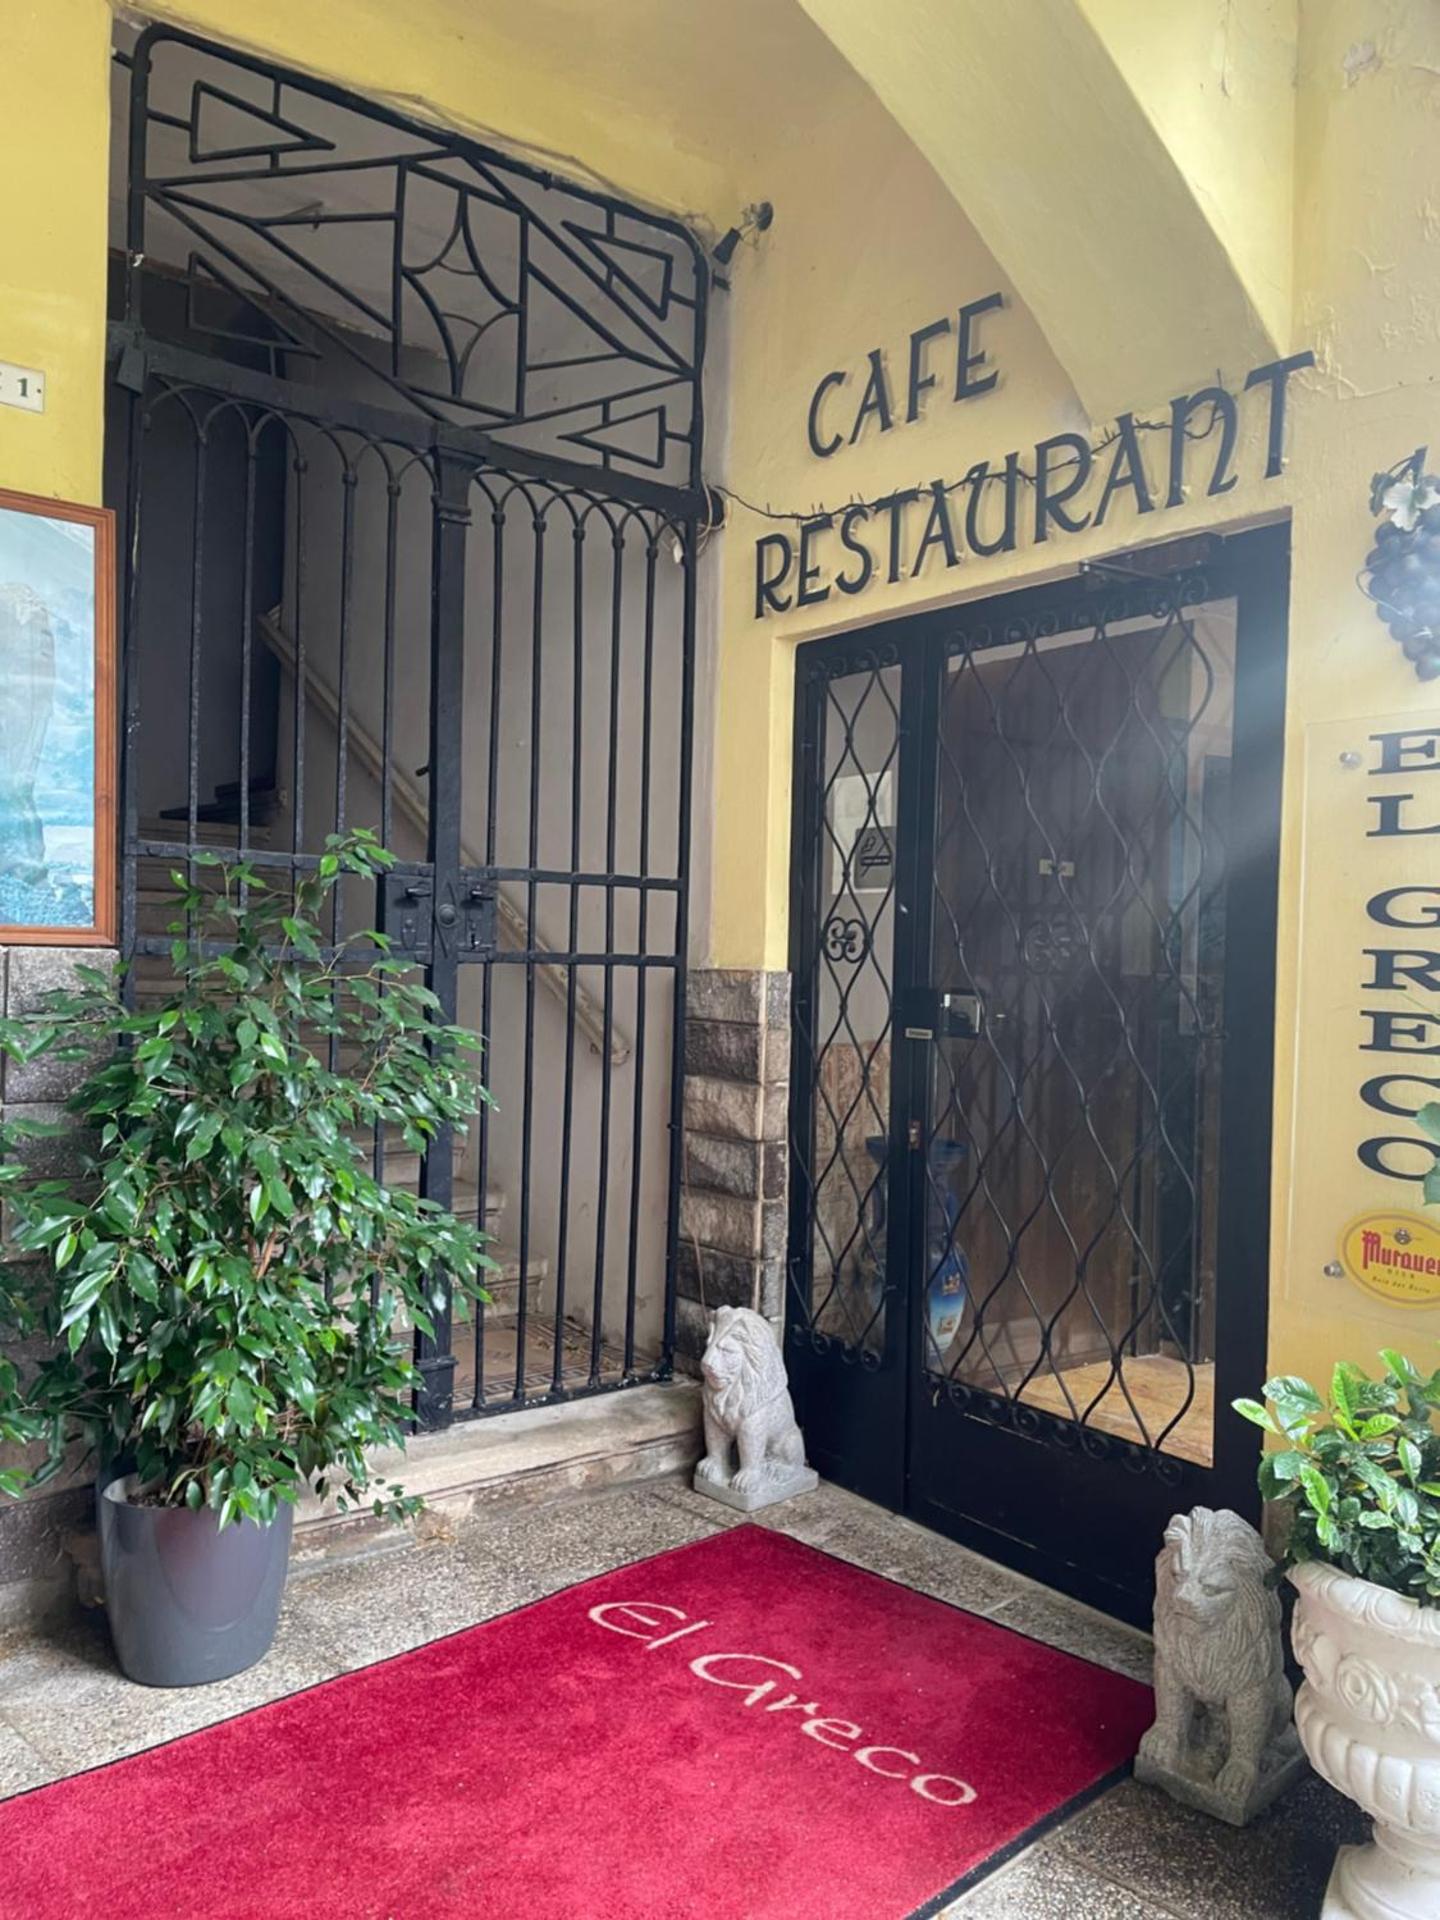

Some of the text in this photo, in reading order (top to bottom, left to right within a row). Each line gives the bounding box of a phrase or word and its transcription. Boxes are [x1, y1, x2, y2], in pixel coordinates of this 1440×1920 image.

[16, 377, 29, 399] 1
[808, 292, 1003, 458] CAFE
[755, 350, 1315, 618] RESTAURANT
[588, 1601, 978, 1806] El Greco
